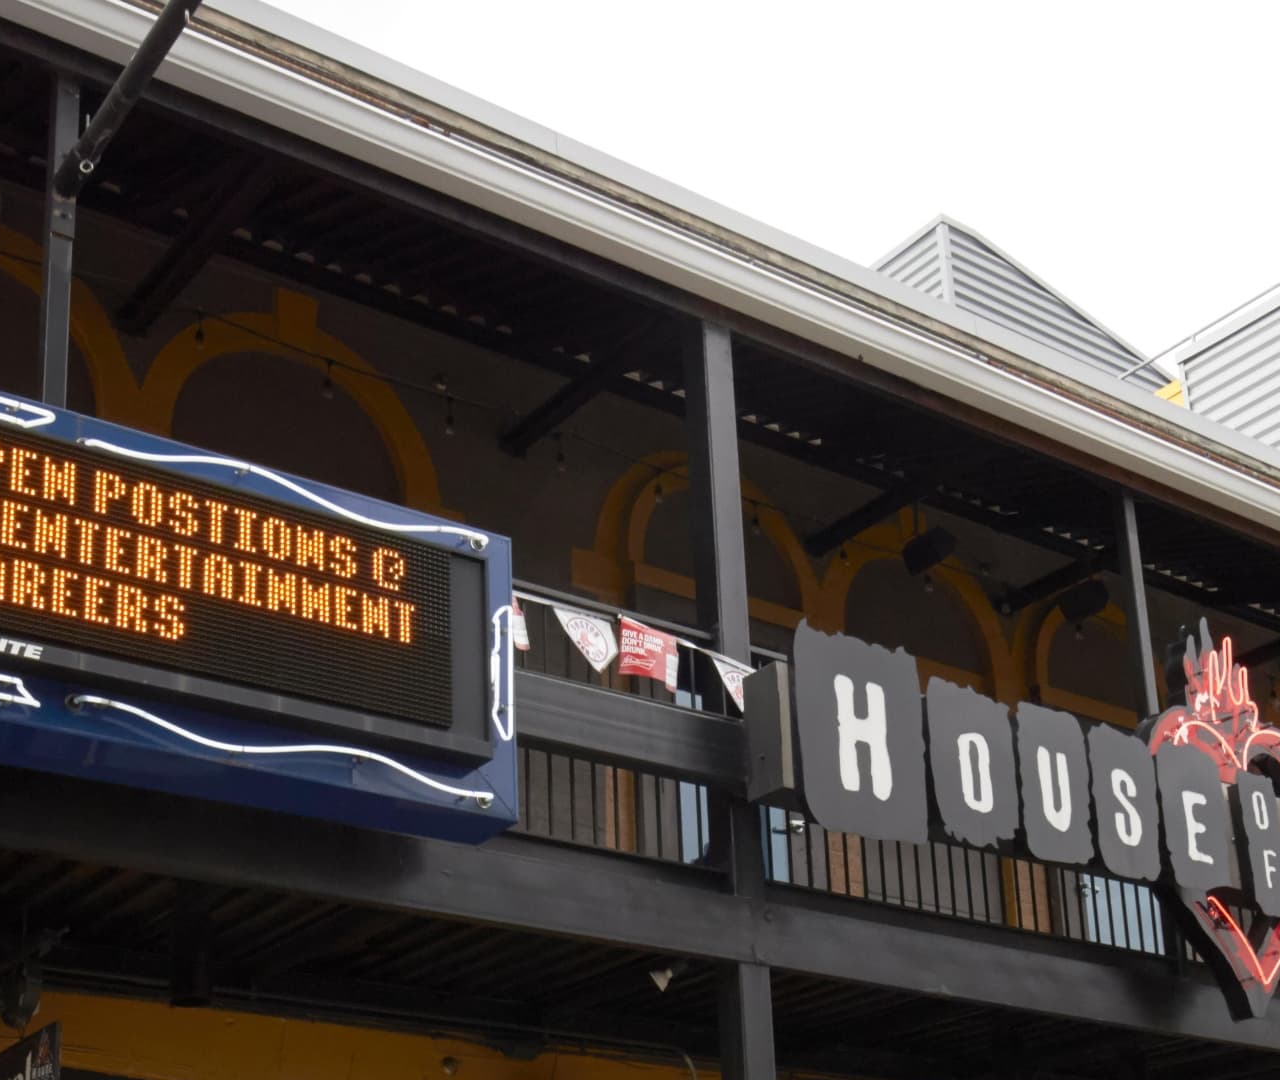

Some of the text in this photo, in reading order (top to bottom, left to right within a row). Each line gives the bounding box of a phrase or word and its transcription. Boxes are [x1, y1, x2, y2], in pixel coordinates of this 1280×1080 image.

[94, 470, 357, 579] POSTIONS
[833, 674, 1214, 865] HOUSE
[1251, 791, 1277, 889] OF
